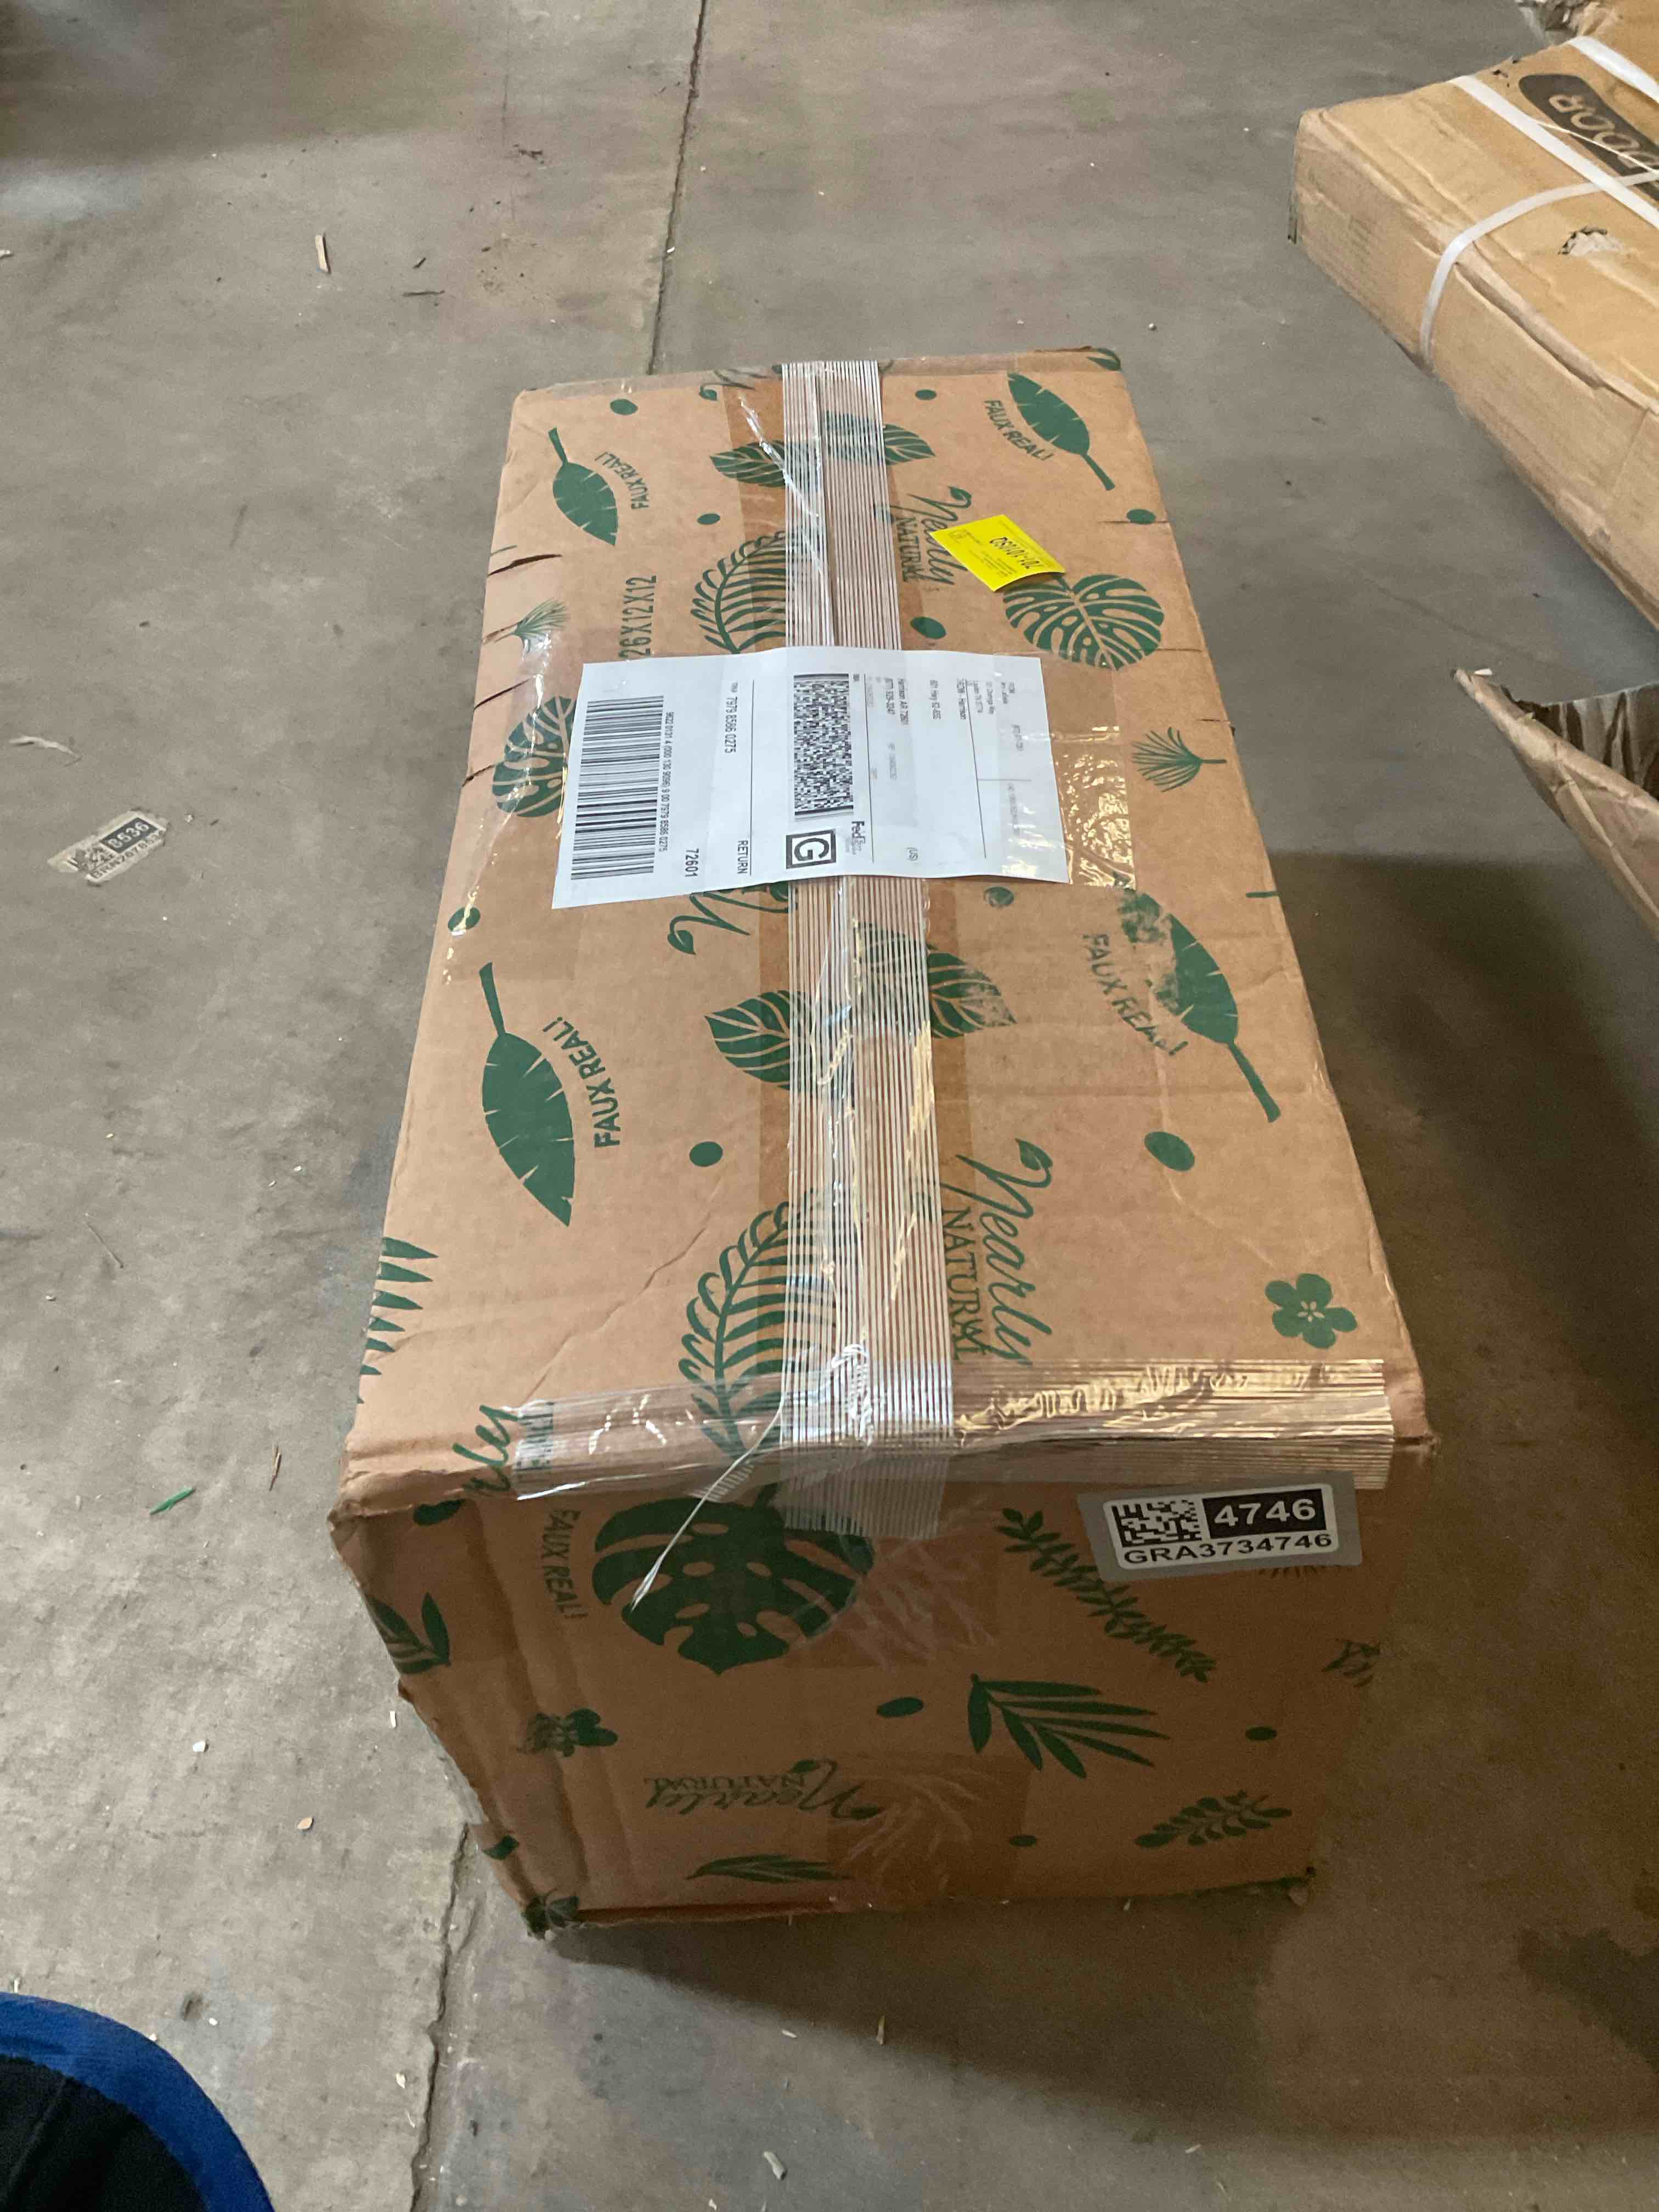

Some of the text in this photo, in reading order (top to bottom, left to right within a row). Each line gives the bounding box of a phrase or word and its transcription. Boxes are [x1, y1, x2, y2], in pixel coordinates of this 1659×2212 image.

[984, 399, 1015, 431] FAUX
[625, 478, 650, 510] FAUX
[618, 575, 657, 658] 26X12X12
[724, 734, 736, 754] 0275
[685, 848, 699, 877] 72601
[737, 840, 748, 874] RETURN
[795, 838, 829, 862] G
[906, 847, 918, 861] (US)
[1083, 934, 1128, 996] FAUX
[542, 1016, 621, 1148] FAUX REAL!
[939, 1137, 1054, 1365] Nearly
[941, 1206, 986, 1363] NATURAL
[1214, 1498, 1317, 1527] 4746
[543, 1509, 589, 1620] FAUX REAL!
[1124, 1534, 1333, 1564] GRA3734746
